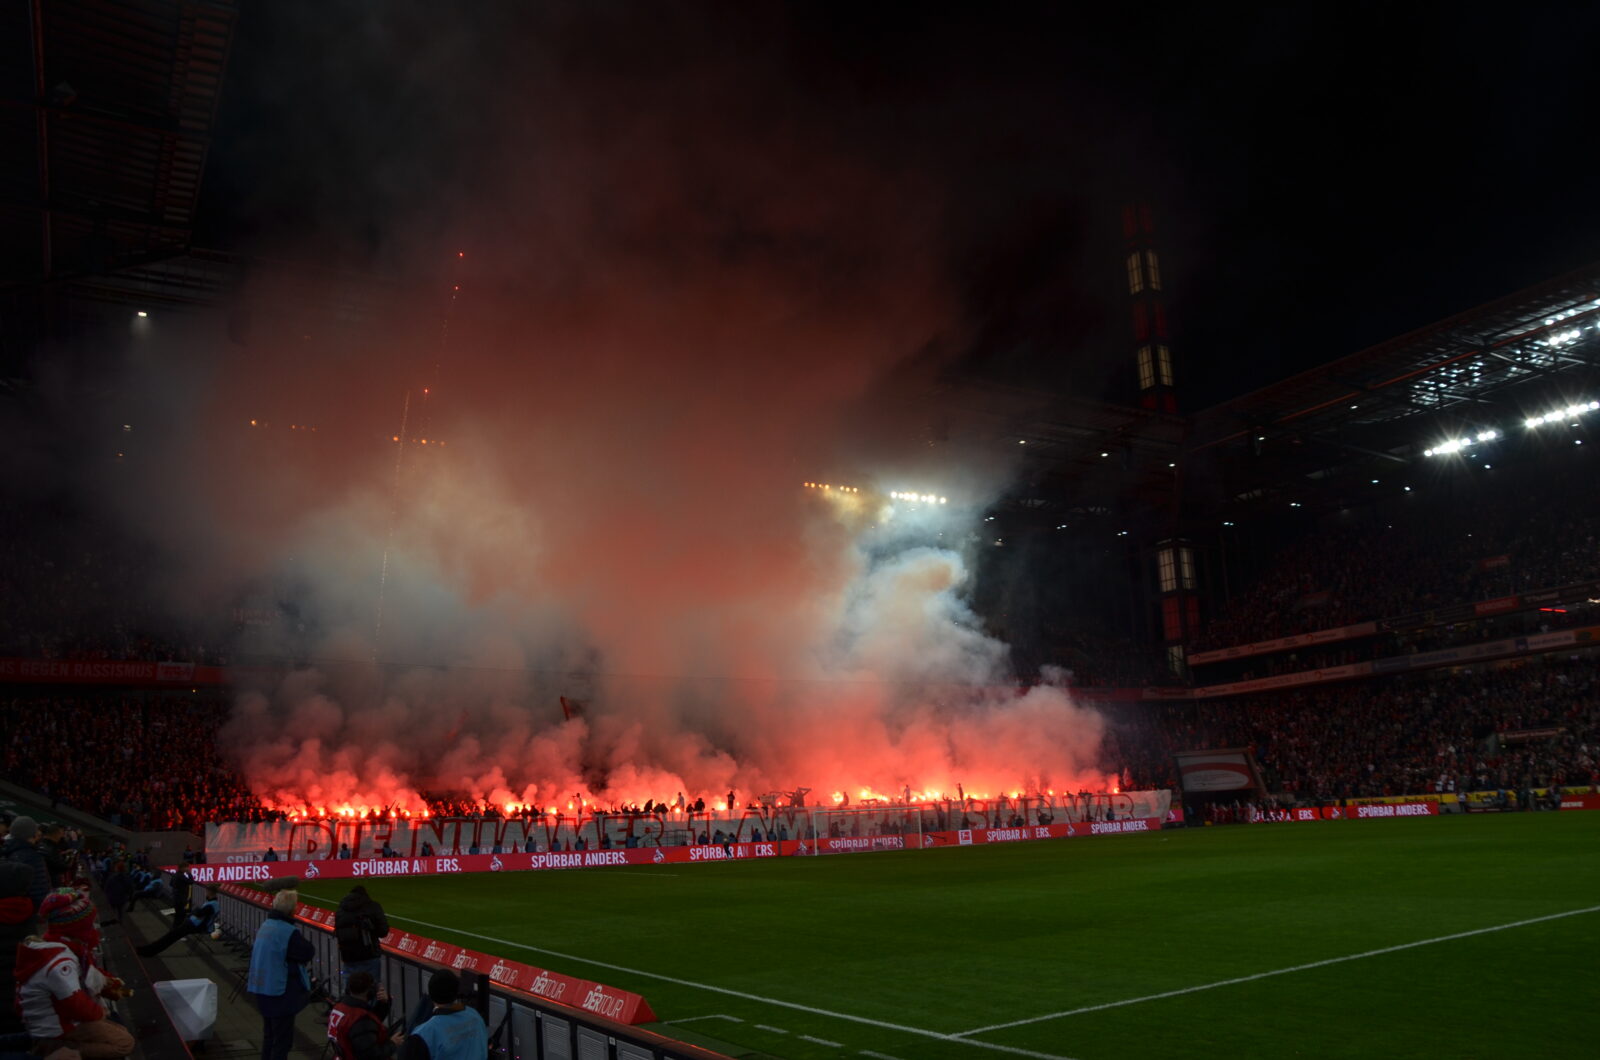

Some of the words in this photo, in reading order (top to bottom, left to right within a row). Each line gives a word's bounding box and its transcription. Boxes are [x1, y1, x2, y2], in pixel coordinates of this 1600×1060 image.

[20, 662, 70, 677] GEGEN
[74, 663, 153, 678] RASSISMUS
[1358, 803, 1397, 817] SPÜRBAR
[1396, 803, 1431, 816] ANDERS.
[413, 814, 664, 858] NUMMER
[987, 828, 1020, 842] SPÜRBAR
[1091, 823, 1121, 836] SPÜRBAR
[1122, 820, 1148, 831] ANDERS.
[531, 853, 582, 869] SPÜRBAR
[585, 852, 629, 866] ANDERS.
[689, 845, 735, 861] SPÜRBAR
[217, 866, 273, 881] ANDERS.
[352, 859, 409, 876] SPÜRBAR
[489, 960, 518, 984] DERTOUR
[531, 971, 565, 1000] DERTOUR
[582, 985, 625, 1018] DERTOUR
